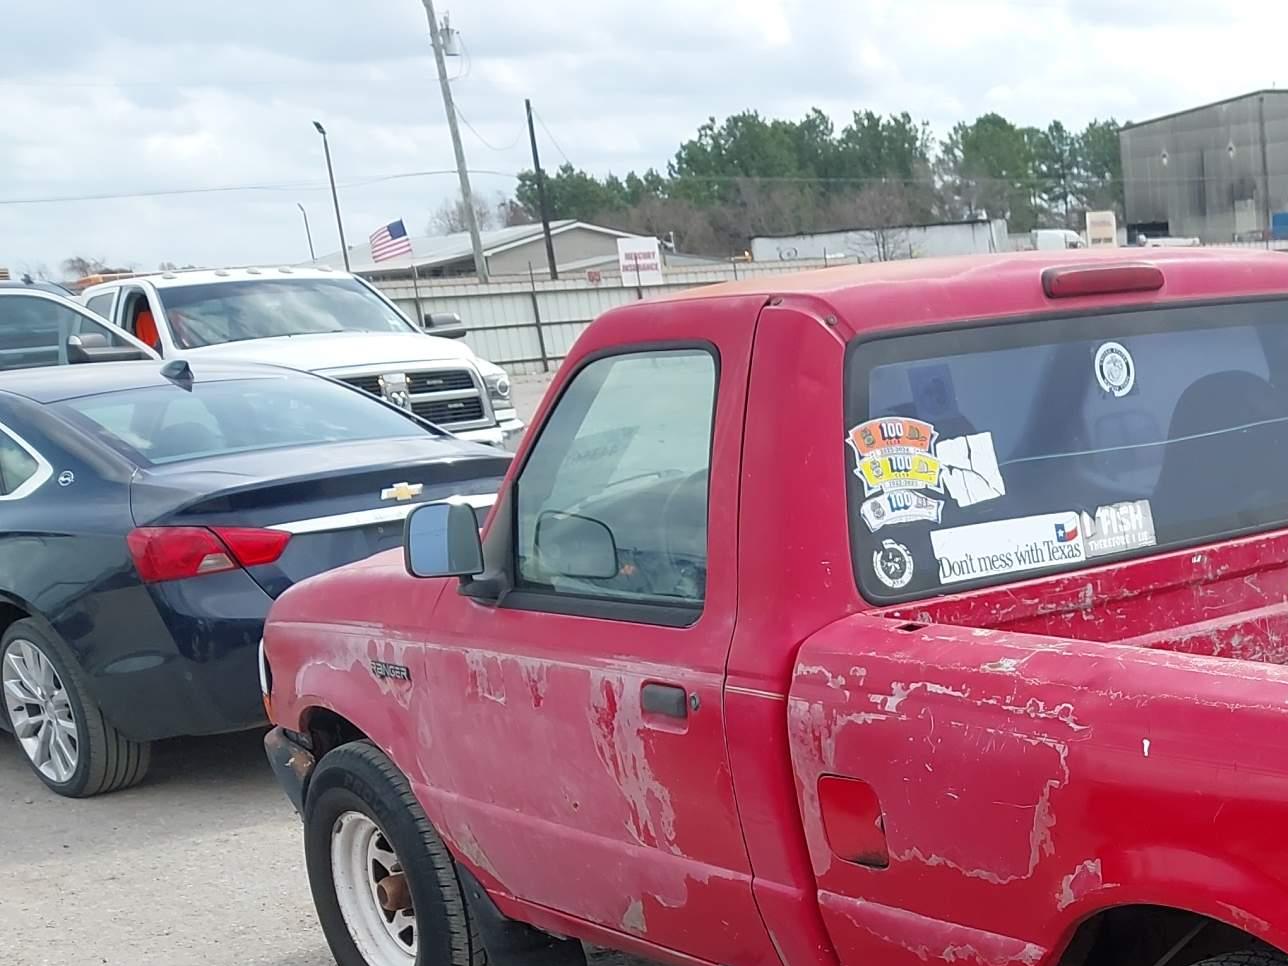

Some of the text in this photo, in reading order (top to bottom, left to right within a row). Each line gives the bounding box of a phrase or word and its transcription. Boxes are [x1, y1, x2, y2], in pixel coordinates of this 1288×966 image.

[880, 422, 903, 440] 100
[889, 456, 912, 472] 100
[889, 493, 912, 512] 100
[939, 554, 977, 579] Don't
[977, 551, 1013, 573] mess
[1014, 542, 1045, 566] with
[1043, 540, 1082, 564] Texas
